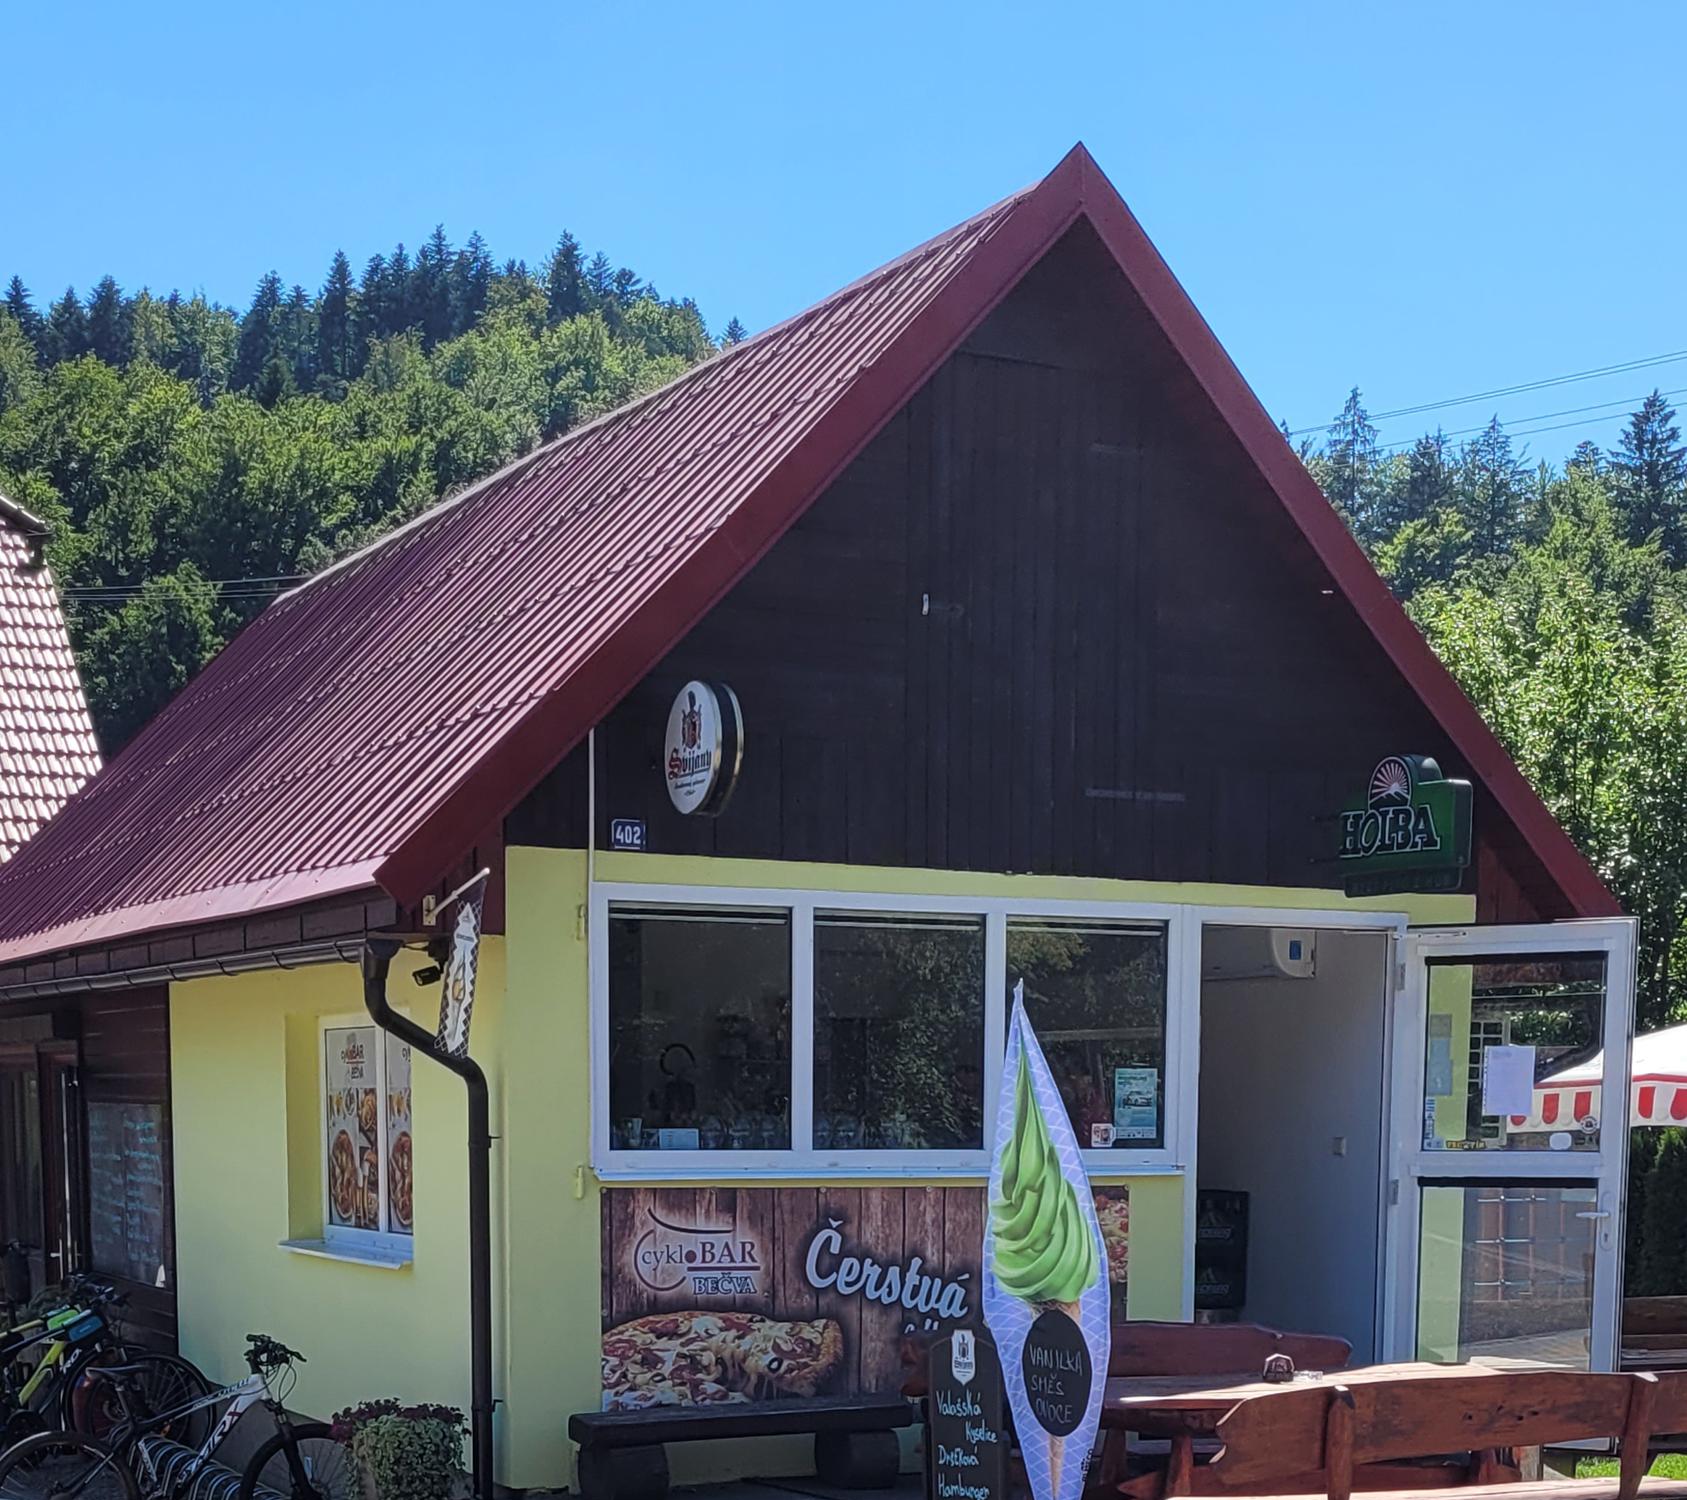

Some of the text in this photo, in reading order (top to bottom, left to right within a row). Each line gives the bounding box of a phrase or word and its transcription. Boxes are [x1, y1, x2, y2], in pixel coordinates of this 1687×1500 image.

[615, 824, 642, 845] 402
[1339, 804, 1441, 858] HOLBA
[693, 1272, 757, 1295] BEČVA
[805, 1217, 969, 1319] Čerstvá
[1029, 1343, 1083, 1376] VANILKA
